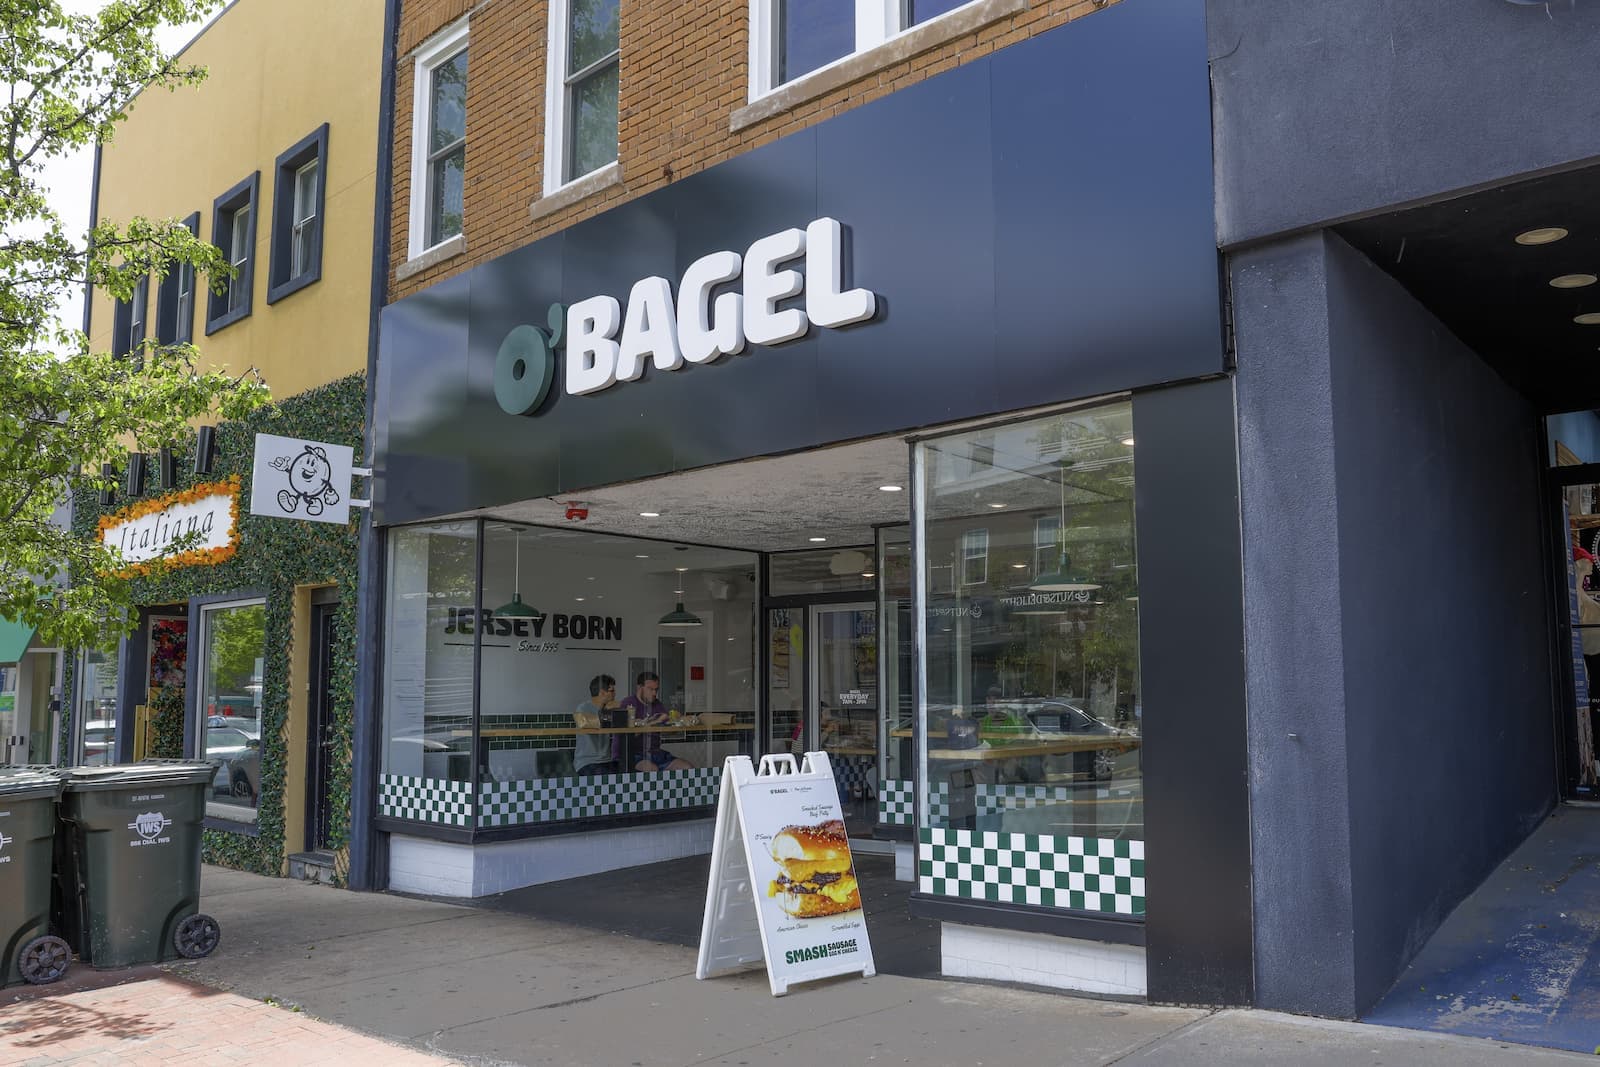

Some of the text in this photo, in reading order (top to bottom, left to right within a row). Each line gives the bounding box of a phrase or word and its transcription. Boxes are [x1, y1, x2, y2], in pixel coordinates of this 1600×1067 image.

[493, 216, 876, 416] O'BAGEL
[120, 509, 215, 552] Italiana
[444, 607, 623, 641] JERSEY BORN
[518, 640, 559, 654] Since 1995
[140, 821, 161, 834] IWS
[785, 938, 857, 964] SMASH SAUSAGE
